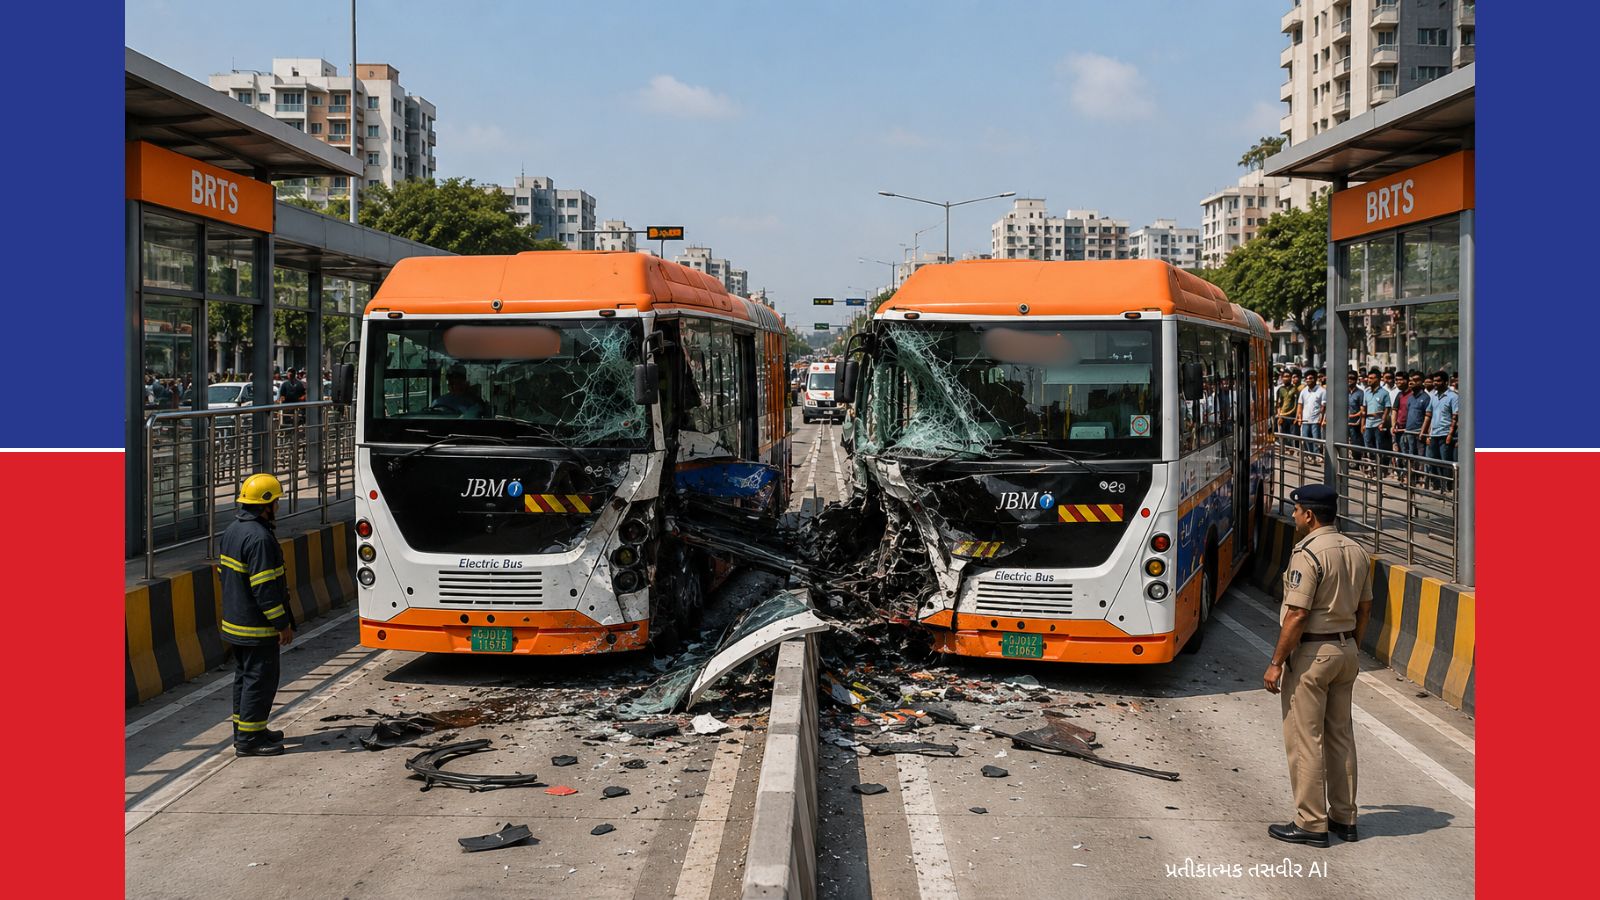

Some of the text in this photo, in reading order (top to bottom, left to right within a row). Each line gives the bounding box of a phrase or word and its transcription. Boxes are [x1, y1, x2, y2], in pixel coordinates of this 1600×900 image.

[191, 169, 239, 215] BRTS
[1366, 179, 1414, 224] BRTS
[458, 558, 523, 569] Electric Bus
[994, 570, 1055, 583] Electric Bus
